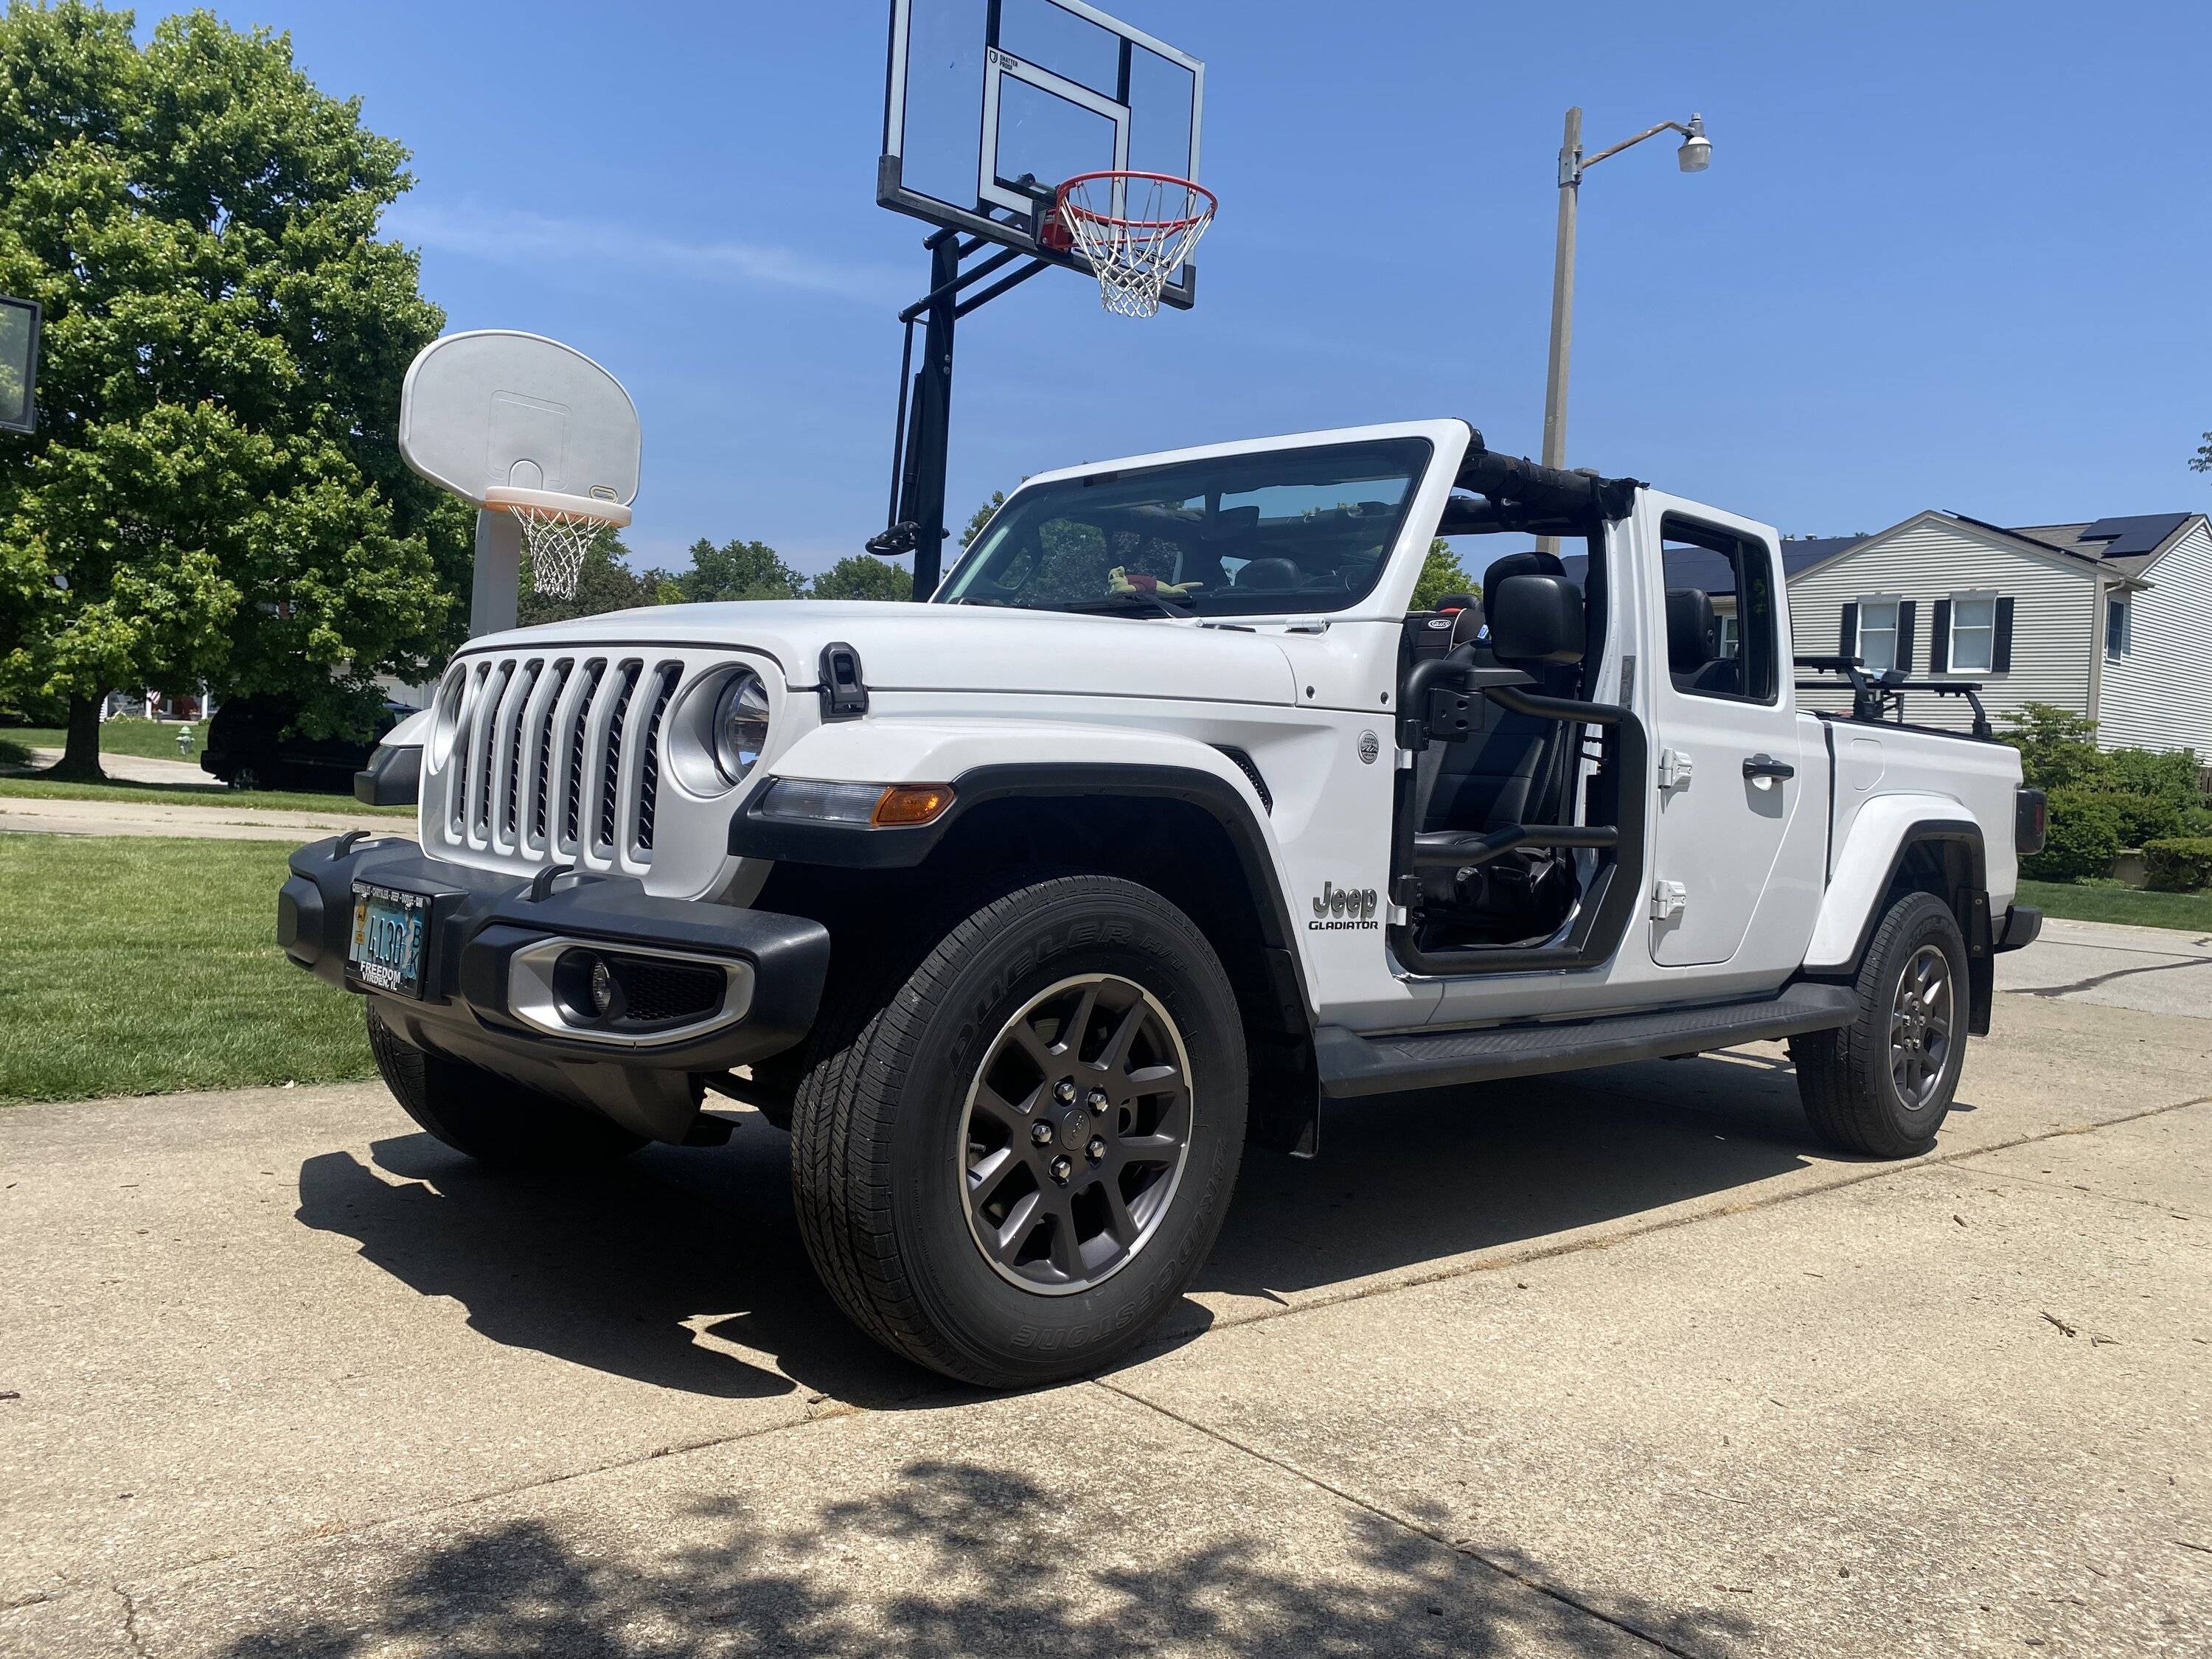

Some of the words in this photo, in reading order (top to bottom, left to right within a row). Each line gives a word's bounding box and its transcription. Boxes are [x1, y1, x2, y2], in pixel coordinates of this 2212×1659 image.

[999, 54, 1018, 68] SHATTER
[999, 61, 1013, 71] PROOF
[1312, 881, 1377, 920] Jeep
[1308, 921, 1378, 930] GLADIATOR
[362, 972, 389, 989] VIRDEN,
[390, 981, 397, 991] IL
[946, 921, 1133, 1075] DUELER
[1138, 935, 1189, 973] H/T
[1010, 1138, 1225, 1351] BRIDGESTONE
